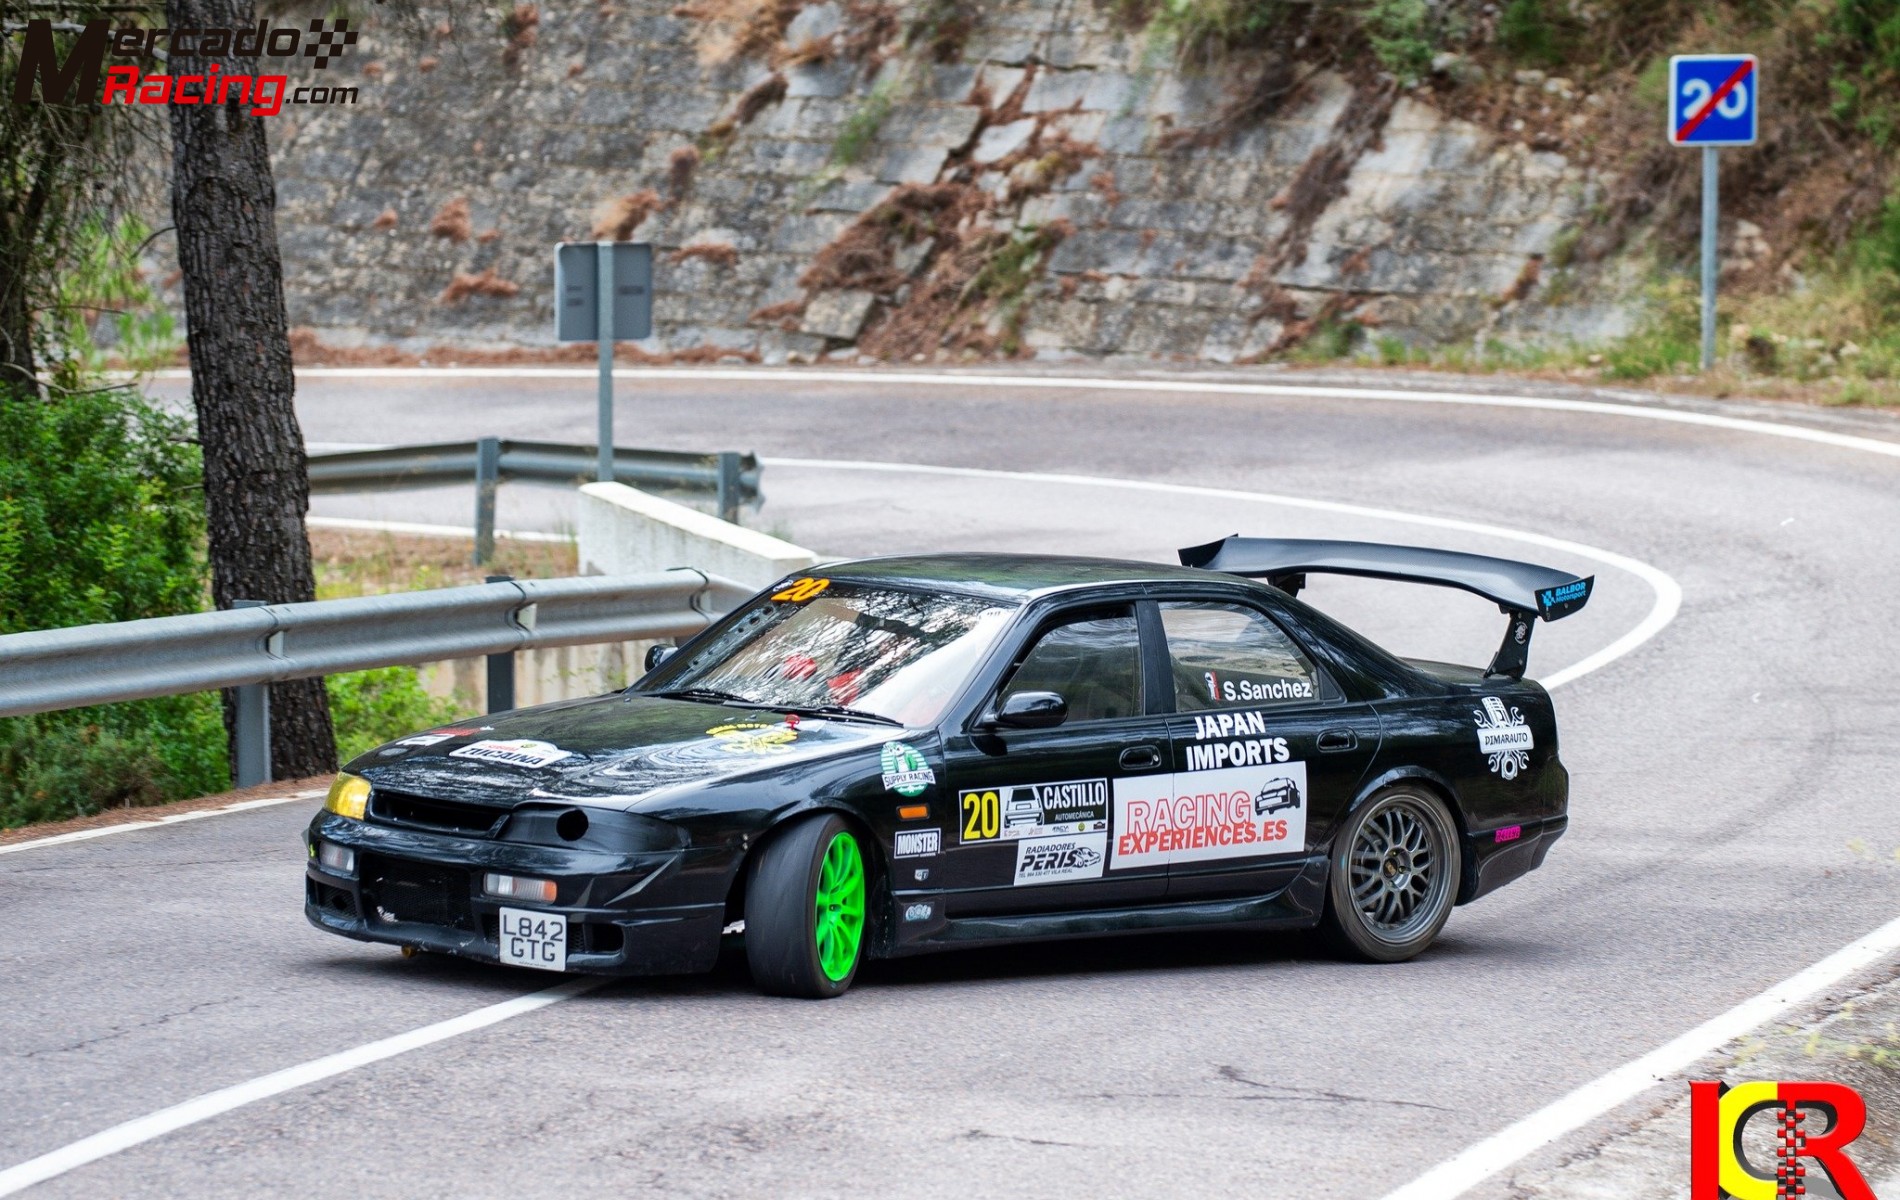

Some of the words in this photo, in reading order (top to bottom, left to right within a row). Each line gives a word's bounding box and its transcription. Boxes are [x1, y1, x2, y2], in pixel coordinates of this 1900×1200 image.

[1682, 78, 1748, 119] 20
[770, 577, 831, 602] 20
[1555, 581, 1586, 597] BALBOR
[1223, 678, 1313, 702] S.Sanchez
[1194, 711, 1266, 740] JAPAN
[1484, 732, 1528, 746] DIMARAUTO
[458, 747, 546, 766] ZUCAINA
[1185, 737, 1290, 771] IMPORTS
[884, 773, 907, 788] SUPPLY
[908, 770, 934, 782] RACING
[1043, 782, 1105, 811] CASTILLO
[963, 791, 999, 840] 20
[1127, 790, 1251, 835] RACING
[896, 832, 939, 856] MONSTER
[1025, 842, 1076, 855] RADIADORES
[1118, 819, 1288, 856] EXPERIENCES.ES
[1019, 850, 1079, 872] PERIS
[503, 914, 563, 942] L842
[511, 937, 556, 962] GTG
